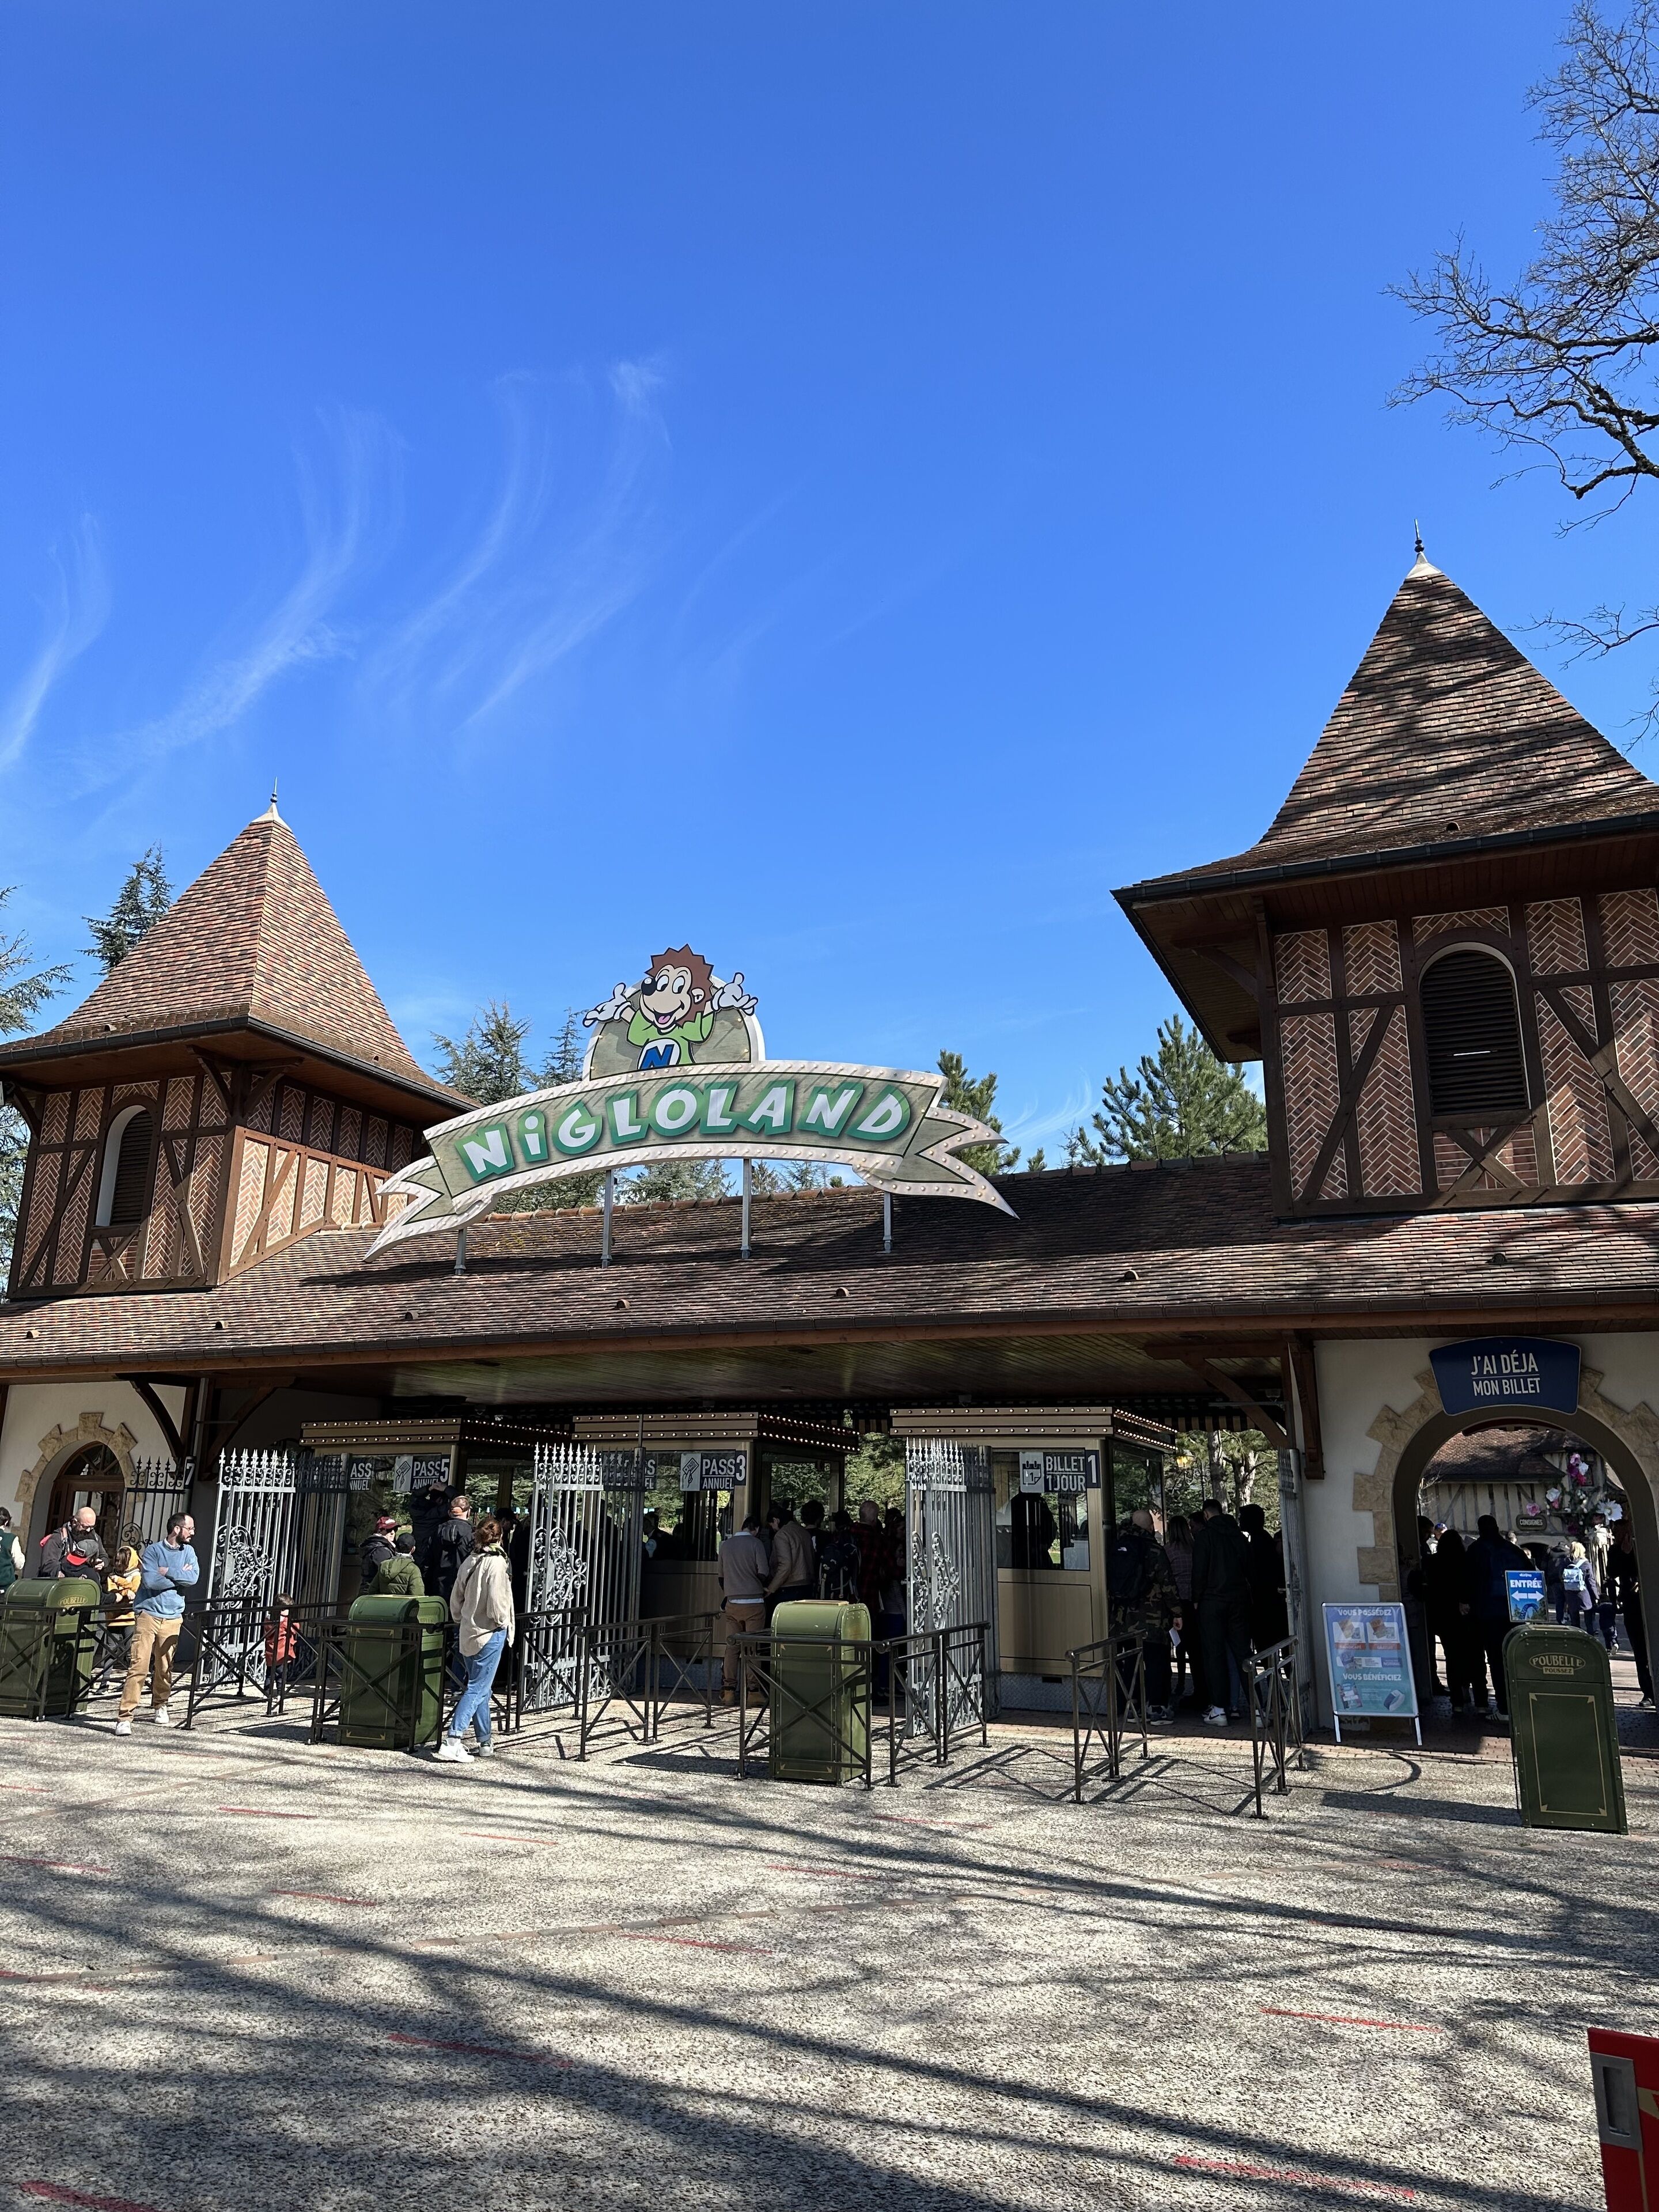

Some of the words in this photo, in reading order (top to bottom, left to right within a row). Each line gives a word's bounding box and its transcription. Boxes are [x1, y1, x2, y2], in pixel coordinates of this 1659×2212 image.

[639, 1044, 675, 1069] N
[1471, 1354, 1497, 1376] J'AI
[1500, 1349, 1539, 1374] DÉJA
[1472, 1380, 1499, 1396] MON
[1502, 1377, 1540, 1395] BILLET
[350, 1463, 372, 1478] ASS
[413, 1461, 441, 1476] PASS
[440, 1459, 450, 1482] 5
[702, 1459, 735, 1475] PASS
[736, 1455, 746, 1481] 3
[1046, 1456, 1085, 1471] BILLET
[1088, 1455, 1097, 1483] 1
[185, 1463, 195, 1485] 7
[1029, 1472, 1034, 1482] 1
[702, 1478, 734, 1490] ANNUEL
[1510, 1577, 1543, 1588] ENTRÉE
[1358, 1607, 1392, 1616] POSSÉDEZ
[1343, 1673, 1362, 1681] VOUS
[1363, 1672, 1402, 1681] BÉNÉFICIEZ
